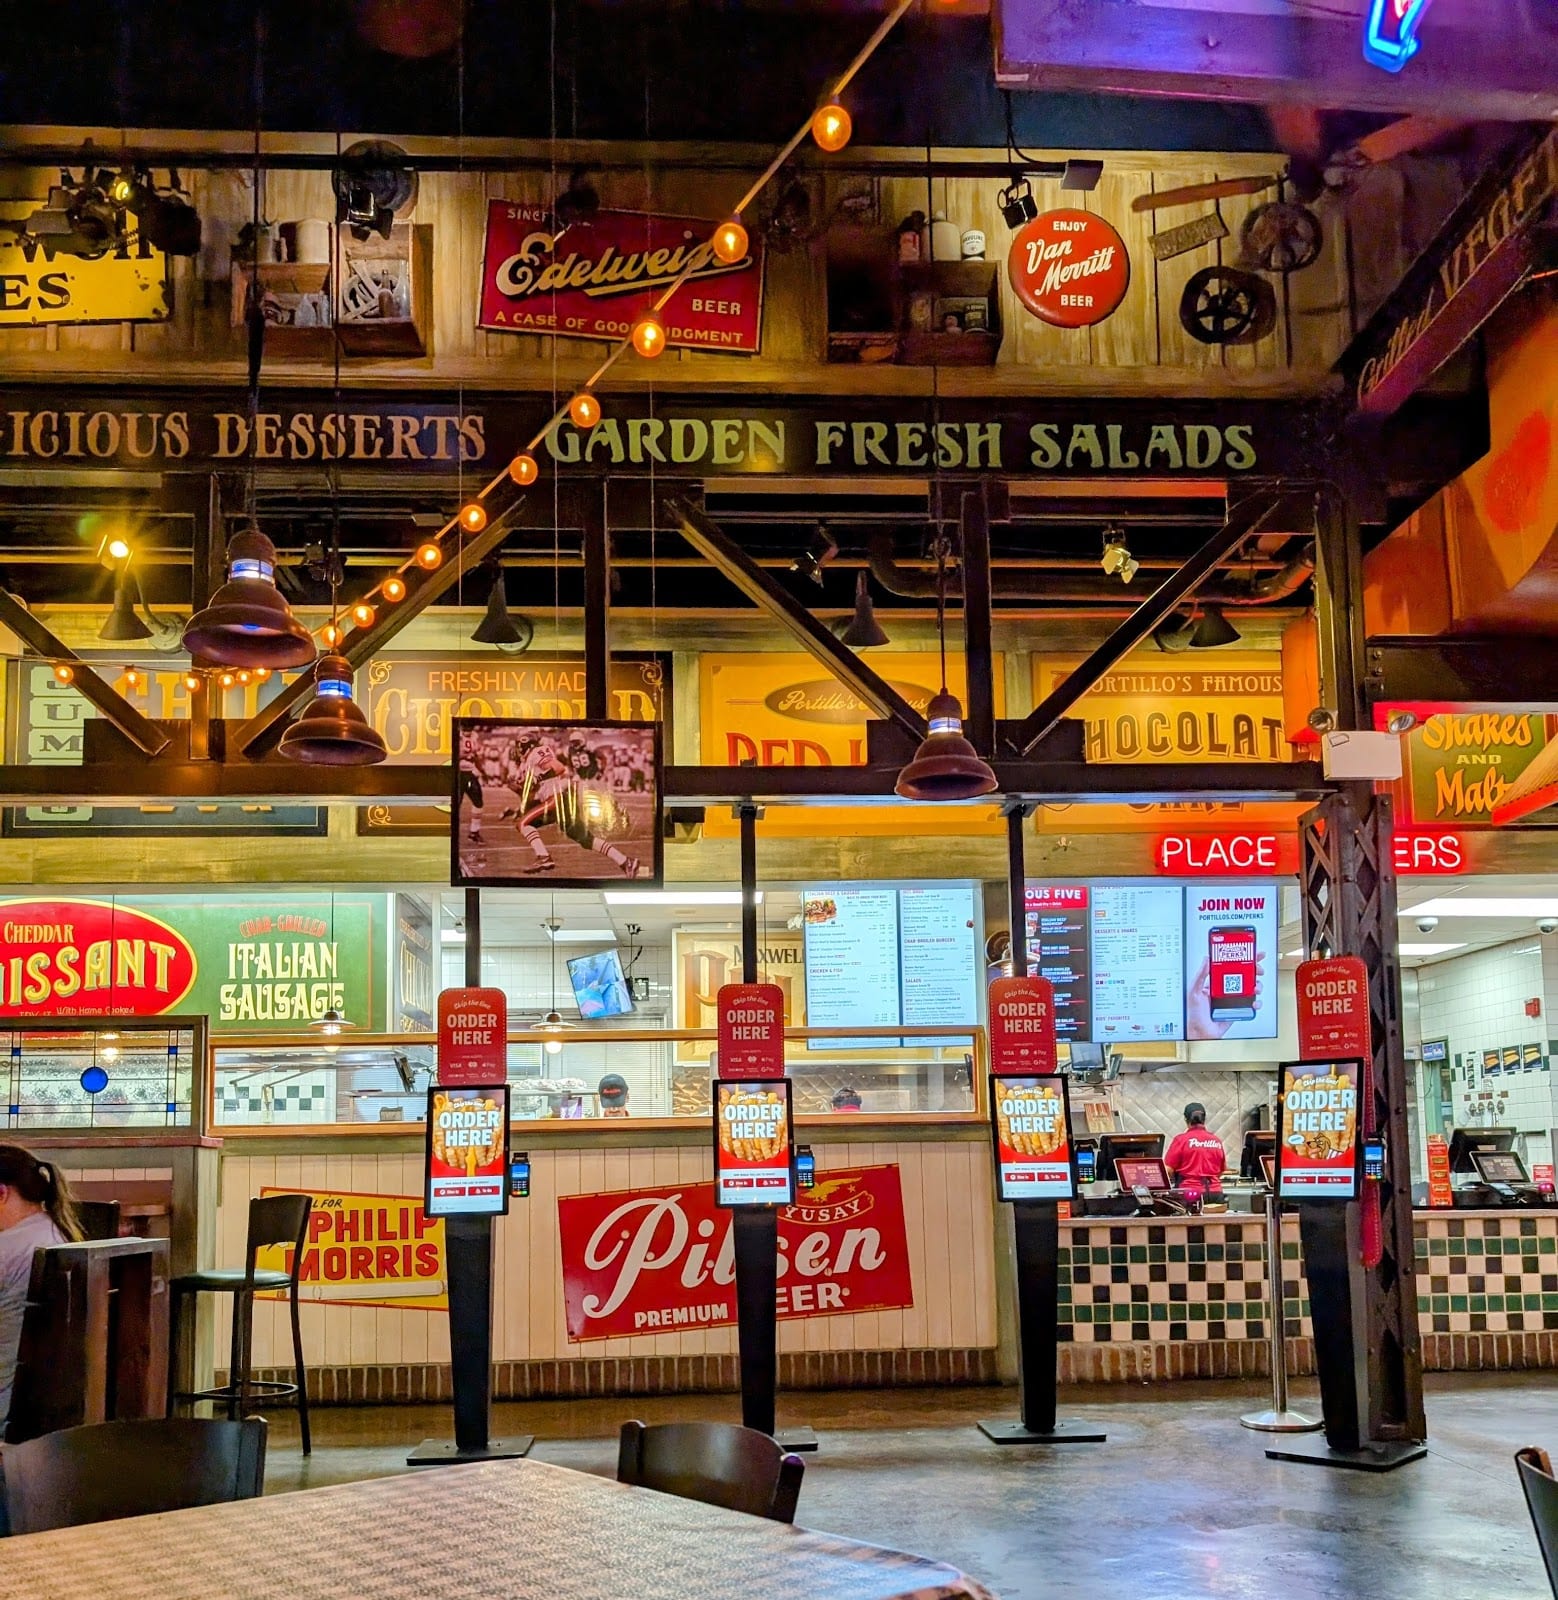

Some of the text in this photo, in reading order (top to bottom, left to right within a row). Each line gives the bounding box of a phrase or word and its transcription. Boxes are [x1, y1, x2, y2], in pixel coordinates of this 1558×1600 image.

[1052, 220, 1087, 233] ENJOY
[495, 230, 753, 297] Edelwei
[1026, 237, 1073, 274] Van
[1034, 246, 1115, 296] Merritt
[692, 298, 742, 316] BEER
[1060, 294, 1094, 308] BEER
[494, 311, 744, 344] A CASE OF GOO UDGMENT
[0, 411, 487, 461] ICIOUS DESSERTS
[544, 417, 1258, 470] GARDEN FRESH SALADS
[428, 671, 587, 692] FRESHLY MAD
[1095, 675, 1283, 693] ORTILLO'S FAMOUS
[779, 690, 857, 712] Portillo's
[1085, 711, 1286, 763] HOCOLAT
[1456, 754, 1502, 765] AND
[1435, 766, 1515, 816] Malt
[1162, 835, 1462, 868] PLACE ERS
[1025, 889, 1081, 900] OUS FIVE
[1198, 897, 1265, 912] JOIN NOW
[240, 913, 327, 938] CHAR-GRILLED
[1199, 913, 1264, 921] PORTILLOS.COM/PERKS
[4, 922, 75, 944] CHEDDAR
[228, 942, 338, 980] ITALIAN
[734, 945, 805, 966] MXWEL
[0, 938, 177, 1006] ISSANT
[1305, 979, 1358, 998] ORDER
[57, 1007, 76, 1016] With
[79, 1007, 102, 1015] Home
[219, 982, 345, 1021] SAUSAGE
[998, 1003, 1046, 1017] ORDER
[1312, 998, 1353, 1016] HERE
[447, 1013, 497, 1029] ORDER
[726, 1009, 775, 1024] ORDER
[1004, 1019, 1042, 1033] HERE
[452, 1030, 492, 1045] HERE
[732, 1026, 770, 1040] HERE
[1002, 1099, 1060, 1116] ORDER
[1286, 1089, 1355, 1111] ORDER
[439, 1110, 500, 1129] ORDER
[724, 1104, 783, 1121] ORDER
[1293, 1111, 1347, 1132] HERE
[731, 1122, 777, 1139] HERE
[1010, 1116, 1056, 1133] HERE
[445, 1129, 494, 1147] HERE
[320, 1199, 343, 1208] FOR
[784, 1199, 863, 1223] YUSAY
[308, 1207, 439, 1244] PHILIP
[285, 1243, 440, 1282] MORRIS
[776, 1282, 845, 1313] EER
[634, 1302, 728, 1328] PREMIUM
